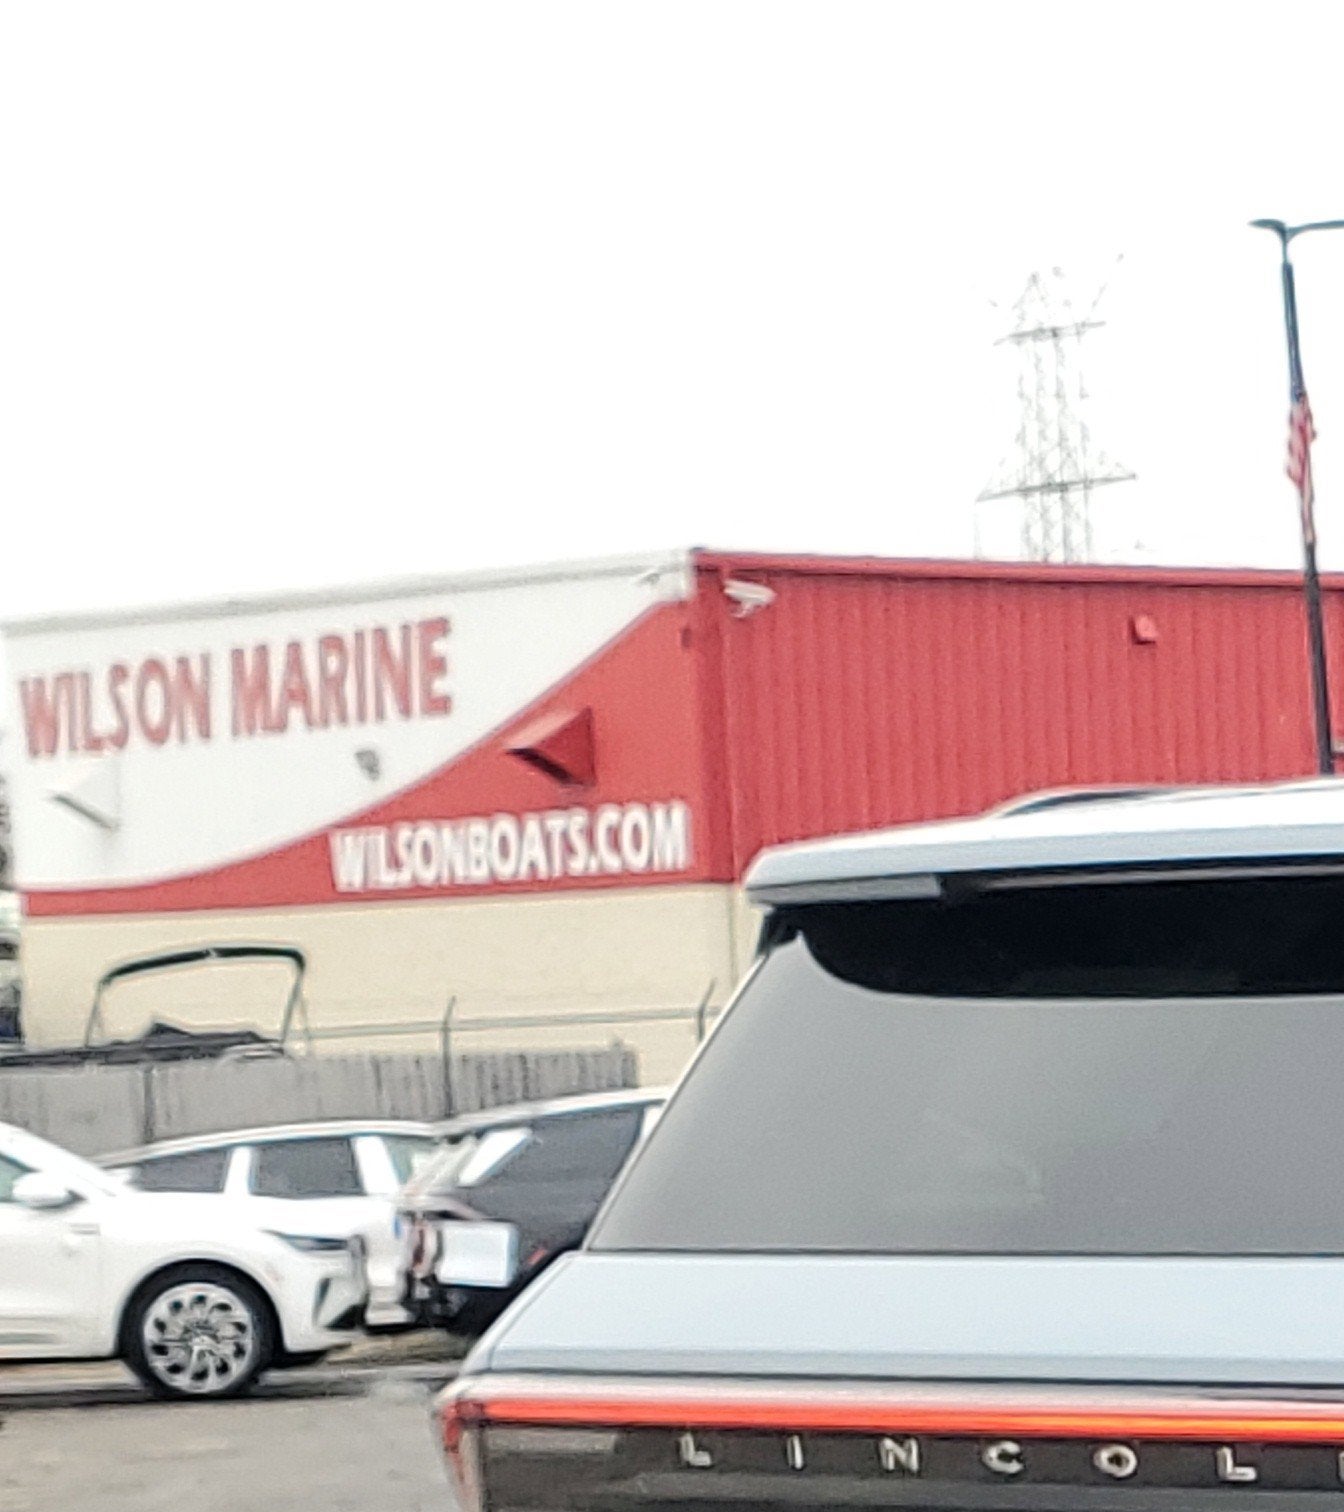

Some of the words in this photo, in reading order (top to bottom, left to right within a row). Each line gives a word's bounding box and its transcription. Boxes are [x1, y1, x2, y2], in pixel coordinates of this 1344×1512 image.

[19, 652, 212, 758] WILSON
[231, 616, 453, 737] MARINE
[330, 801, 690, 890] WILSONBOATS.COM
